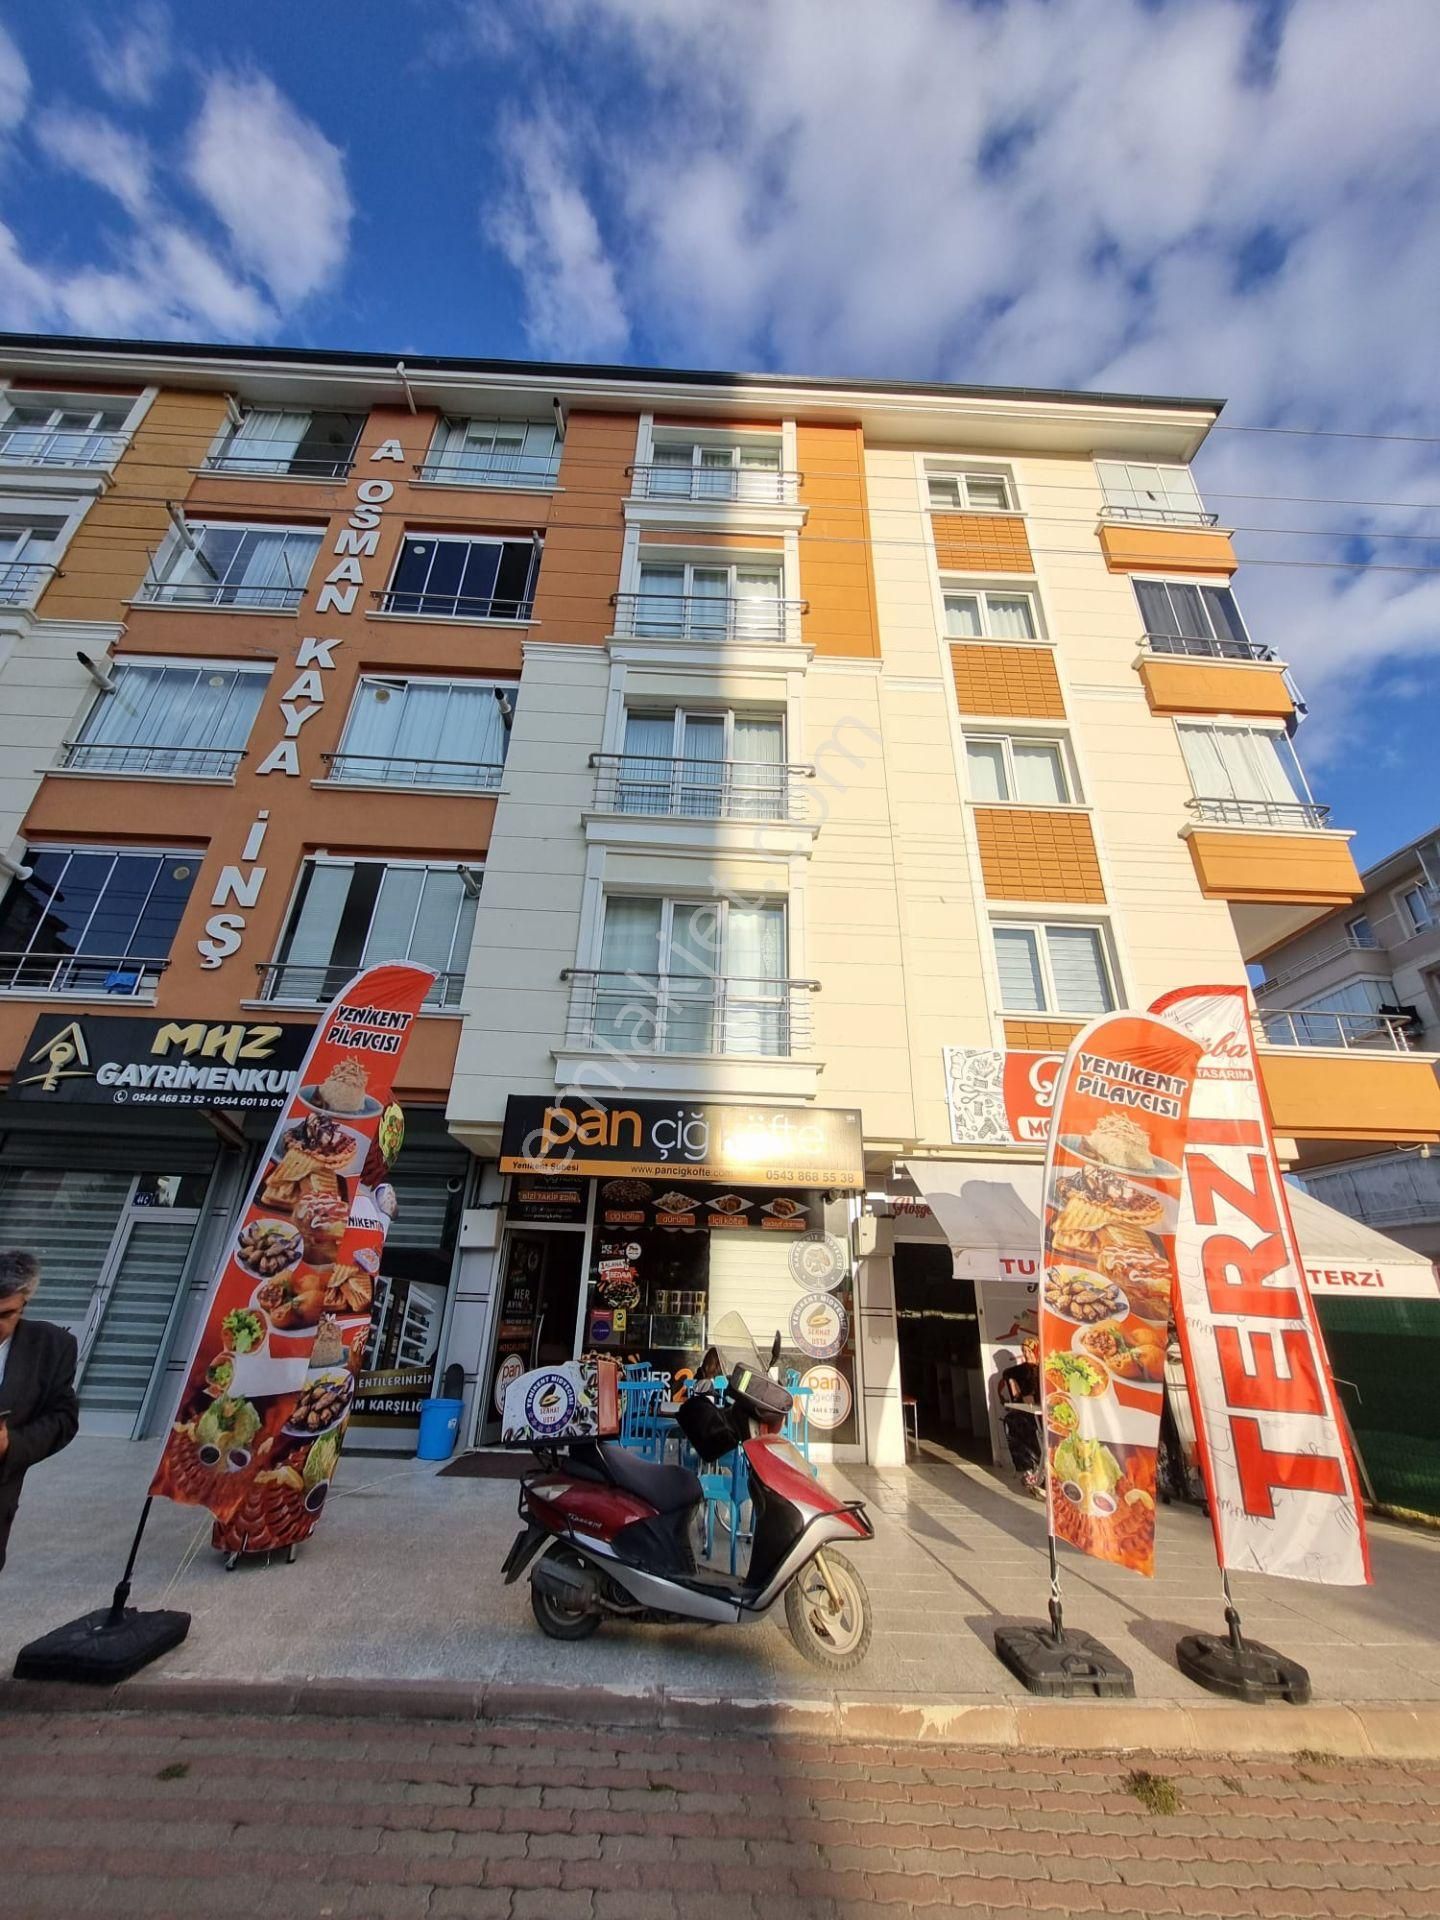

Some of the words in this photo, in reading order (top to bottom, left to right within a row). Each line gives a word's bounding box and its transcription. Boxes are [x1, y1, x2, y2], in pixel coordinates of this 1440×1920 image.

[370, 439, 404, 462] A
[315, 480, 394, 615] OSMAN
[255, 637, 342, 776] KAYA
[197, 810, 269, 969] İNŞ
[336, 1005, 412, 1030] YENİKENT
[150, 1022, 283, 1066] MHZ
[327, 1024, 400, 1053] PİLAVCISI
[1080, 1054, 1187, 1096] YENİKENT
[1196, 1069, 1250, 1080] TASARIM
[132, 1093, 158, 1103] 0544
[159, 1094, 178, 1103] 468
[180, 1095, 191, 1103] 32
[192, 1096, 205, 1104] 52
[213, 1096, 238, 1105] 0544
[240, 1098, 257, 1106] 601
[259, 1098, 269, 1107] 18
[270, 1099, 285, 1107] 00
[1077, 1075, 1179, 1118] PİLAVCISI
[540, 1106, 642, 1154] pan
[651, 1110, 709, 1160] çiğ
[765, 1169, 794, 1181] 0543
[798, 1170, 819, 1182] 868
[822, 1171, 837, 1183] 55
[840, 1172, 855, 1184] 38
[892, 1197, 931, 1218] Hoşge
[1000, 1258, 1040, 1276] TU
[1306, 1268, 1385, 1288] TERZİ
